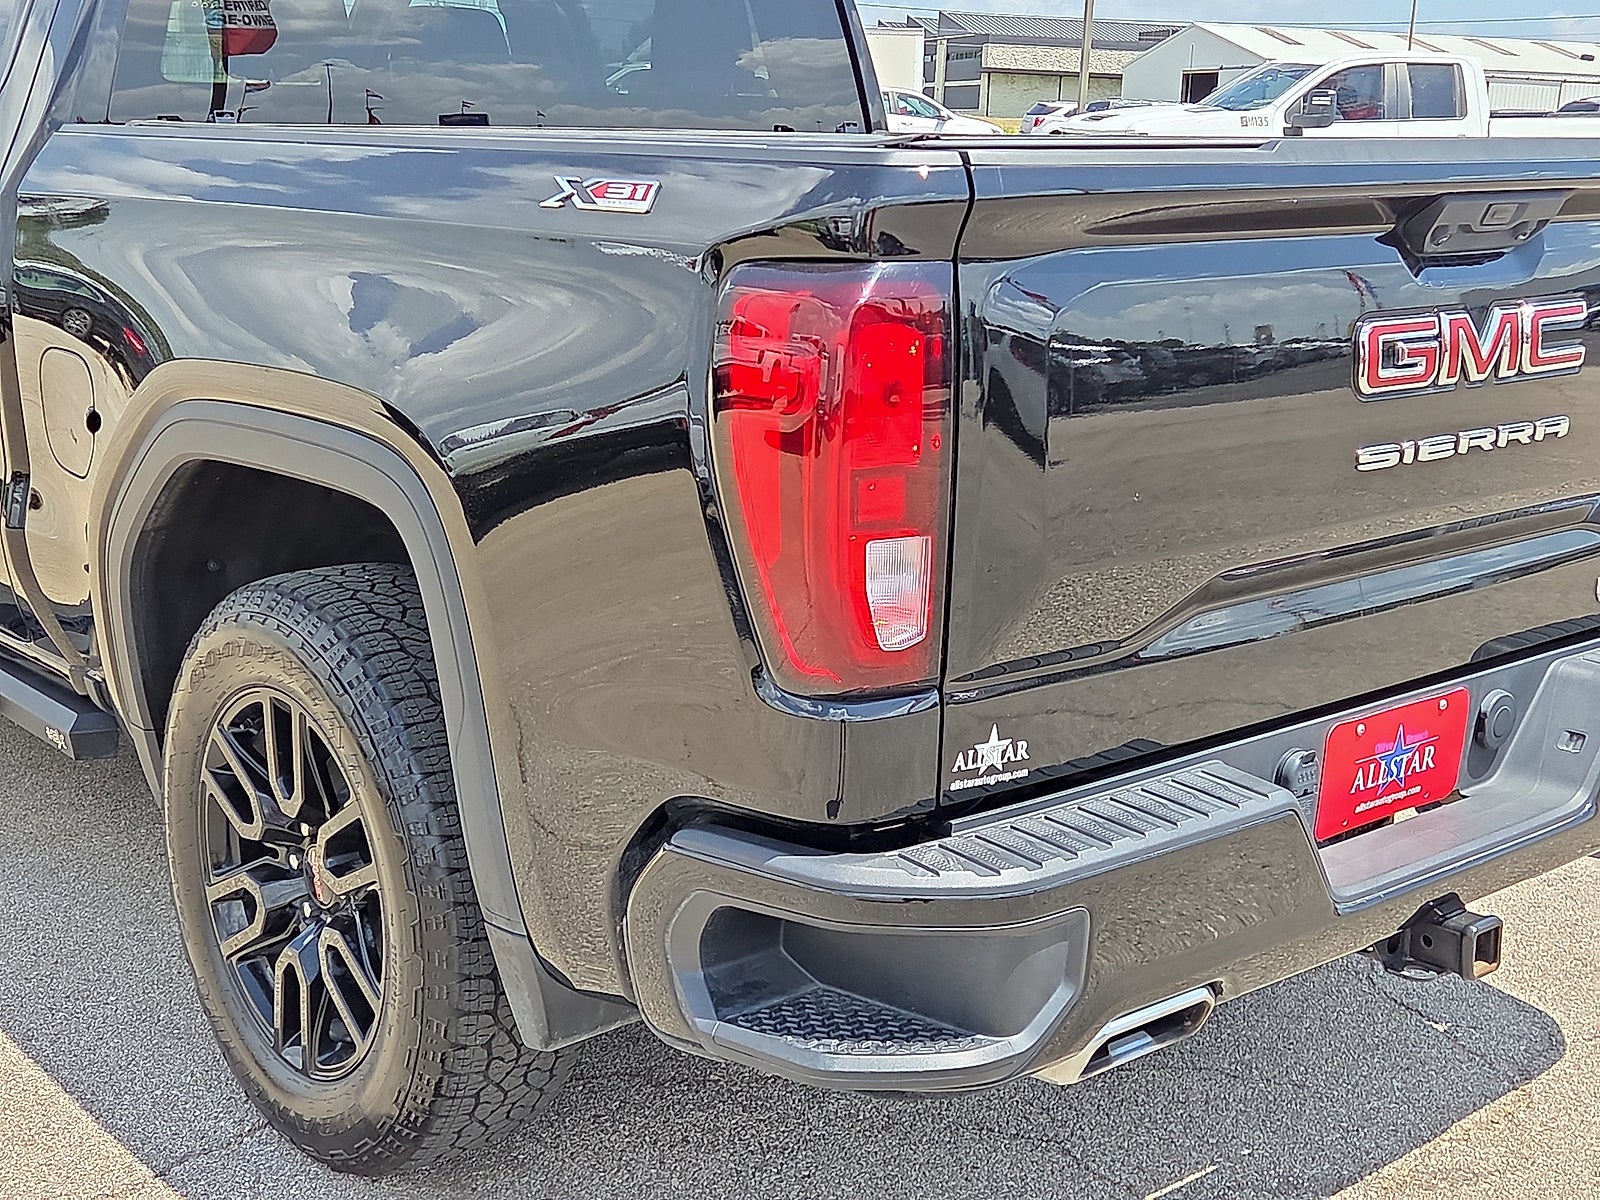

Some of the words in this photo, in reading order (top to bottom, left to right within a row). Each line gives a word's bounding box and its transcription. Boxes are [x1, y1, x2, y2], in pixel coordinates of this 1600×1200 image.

[538, 174, 662, 214] X31
[1352, 295, 1589, 402] GMC
[1354, 414, 1571, 473] SIERRA
[951, 740, 1031, 773] ALLSTAR
[1349, 744, 1436, 794] ALLSTAR
